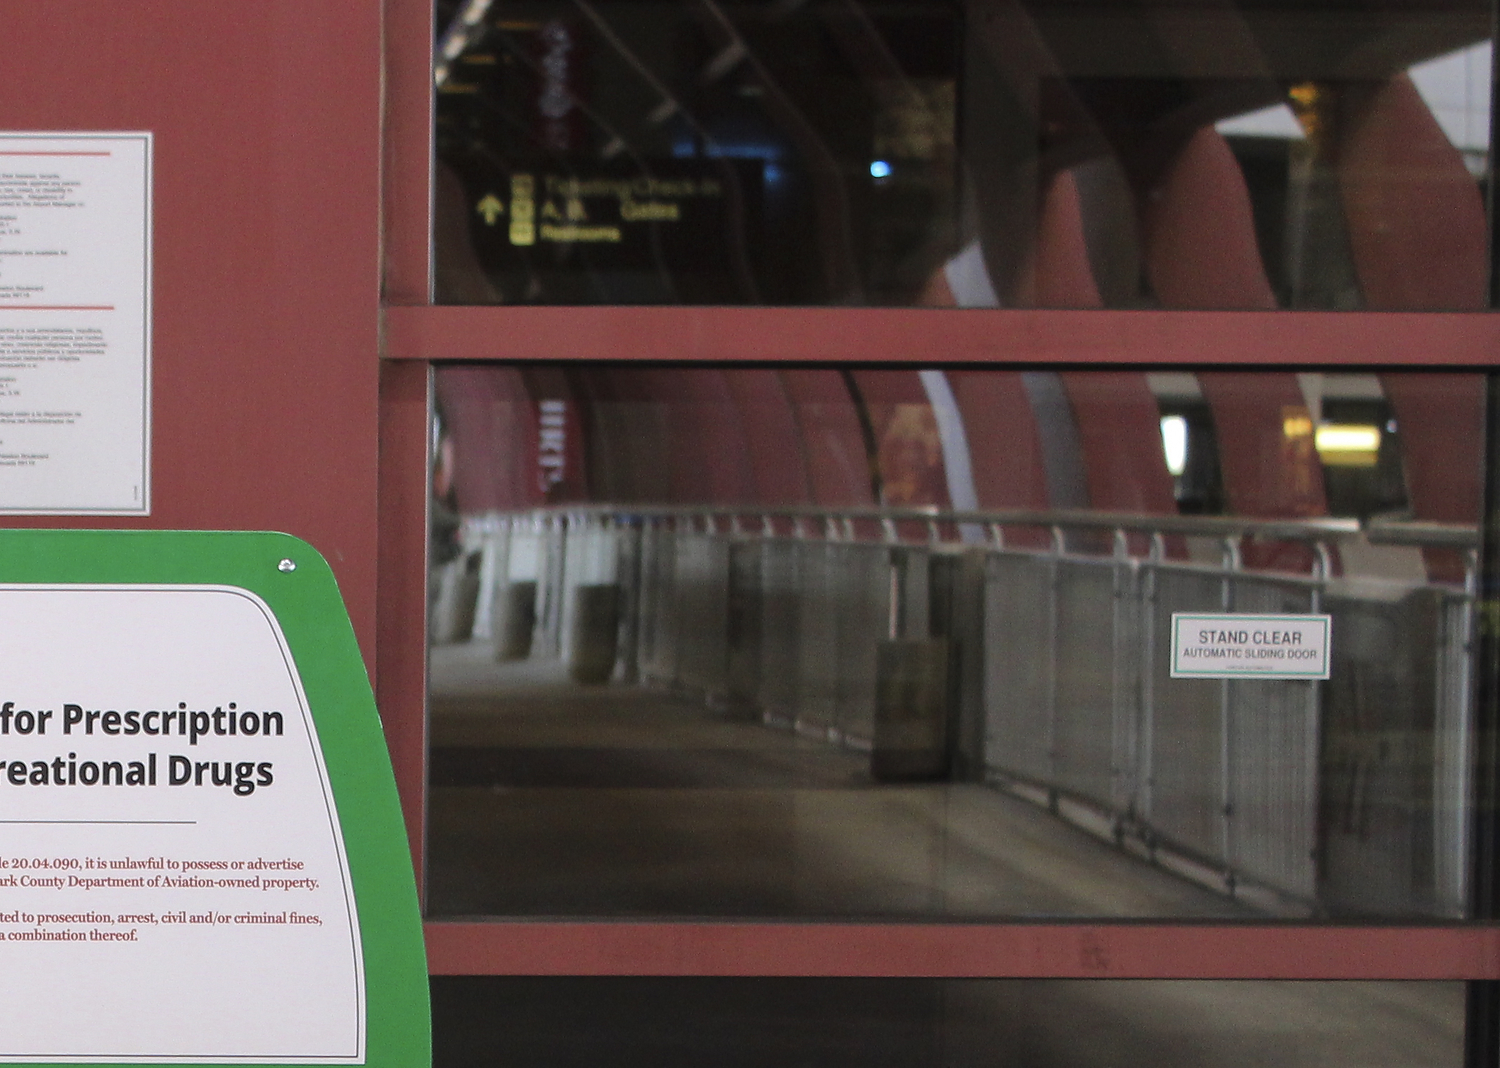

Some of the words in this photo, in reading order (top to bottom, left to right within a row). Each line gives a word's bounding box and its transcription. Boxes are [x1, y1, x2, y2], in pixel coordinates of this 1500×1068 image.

[1198, 629, 1249, 645] STAND
[1252, 630, 1303, 646] CLEAR
[1182, 647, 1243, 660] AUTOMATIC
[1244, 649, 1285, 660] SLIDING
[1287, 649, 1318, 660] DOOR
[0, 701, 53, 736] for
[62, 701, 284, 746] Prescription
[168, 754, 274, 797] Drugs
[11, 857, 83, 872] 20.04.090,
[84, 856, 95, 870] it
[96, 856, 108, 870] is
[109, 856, 165, 870] unlawful
[166, 858, 180, 870] to
[181, 860, 229, 874] possess
[230, 859, 244, 870] or
[247, 857, 305, 871] advertise
[20, 874, 66, 891] County
[67, 875, 145, 891] Department
[146, 874, 160, 888] of
[161, 875, 260, 888] Aviation-owned
[262, 877, 320, 892] property.
[21, 912, 35, 923] to
[36, 910, 115, 927] prosecution,
[117, 912, 159, 926] arrest,
[160, 910, 187, 924] civil
[188, 910, 232, 926] and/or
[233, 910, 288, 924] criminal
[289, 910, 323, 927] fines,
[7, 928, 87, 942] combination
[89, 928, 139, 942] thereof.
